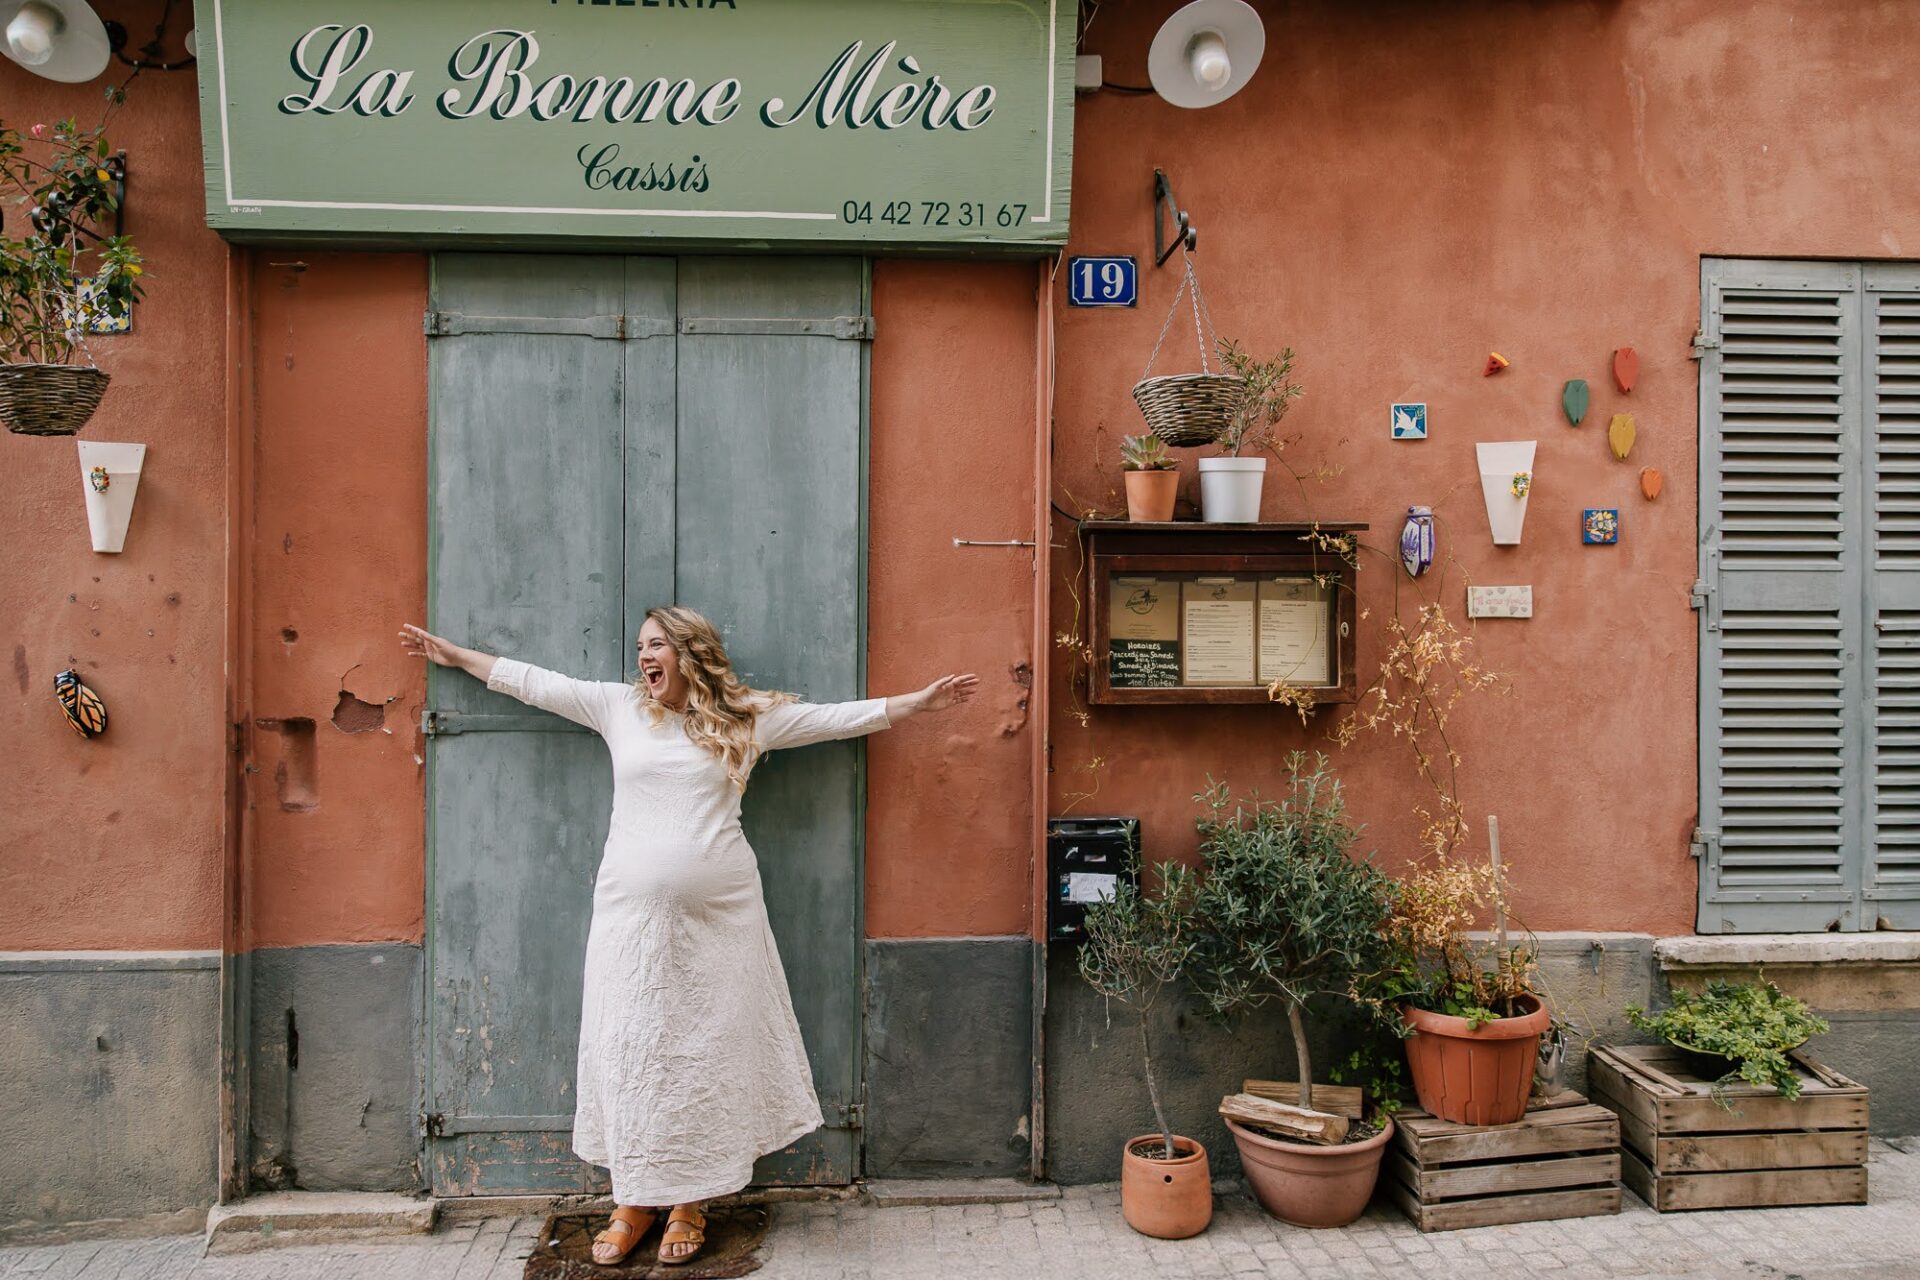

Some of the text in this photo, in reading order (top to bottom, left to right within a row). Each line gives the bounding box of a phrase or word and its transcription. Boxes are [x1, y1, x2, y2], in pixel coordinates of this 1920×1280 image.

[278, 24, 997, 131] La Bonne Mère
[577, 143, 710, 193] Cassis
[842, 201, 1027, 227] 04 42 72 31 67
[1080, 262, 1124, 300] 19
